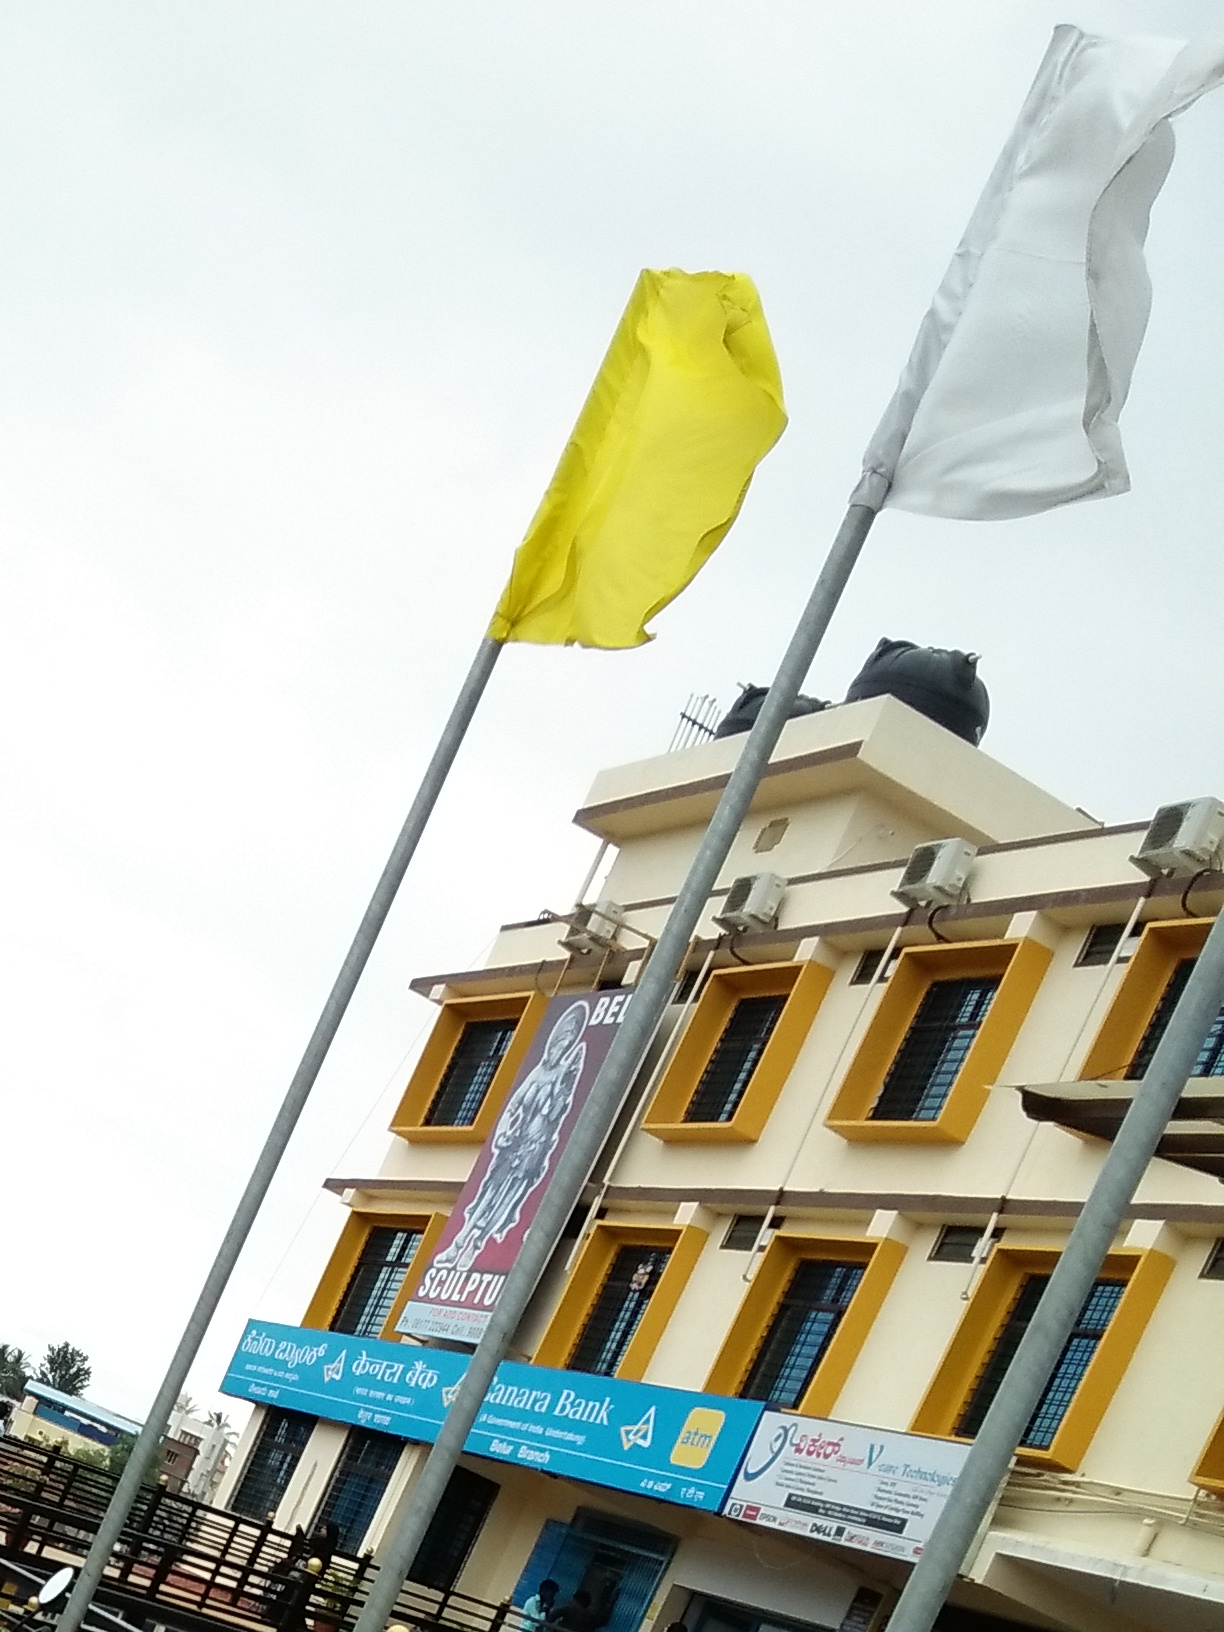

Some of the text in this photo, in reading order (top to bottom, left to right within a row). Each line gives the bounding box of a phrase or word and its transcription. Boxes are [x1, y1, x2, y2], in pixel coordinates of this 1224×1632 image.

[417, 1267, 506, 1306] SCULPTU
[351, 1350, 440, 1390] केनरा बैंक
[553, 1389, 614, 1426] Bank
[489, 1439, 550, 1464] Belur Branch
[681, 1428, 712, 1448] atm
[809, 1522, 834, 1537] DELL
